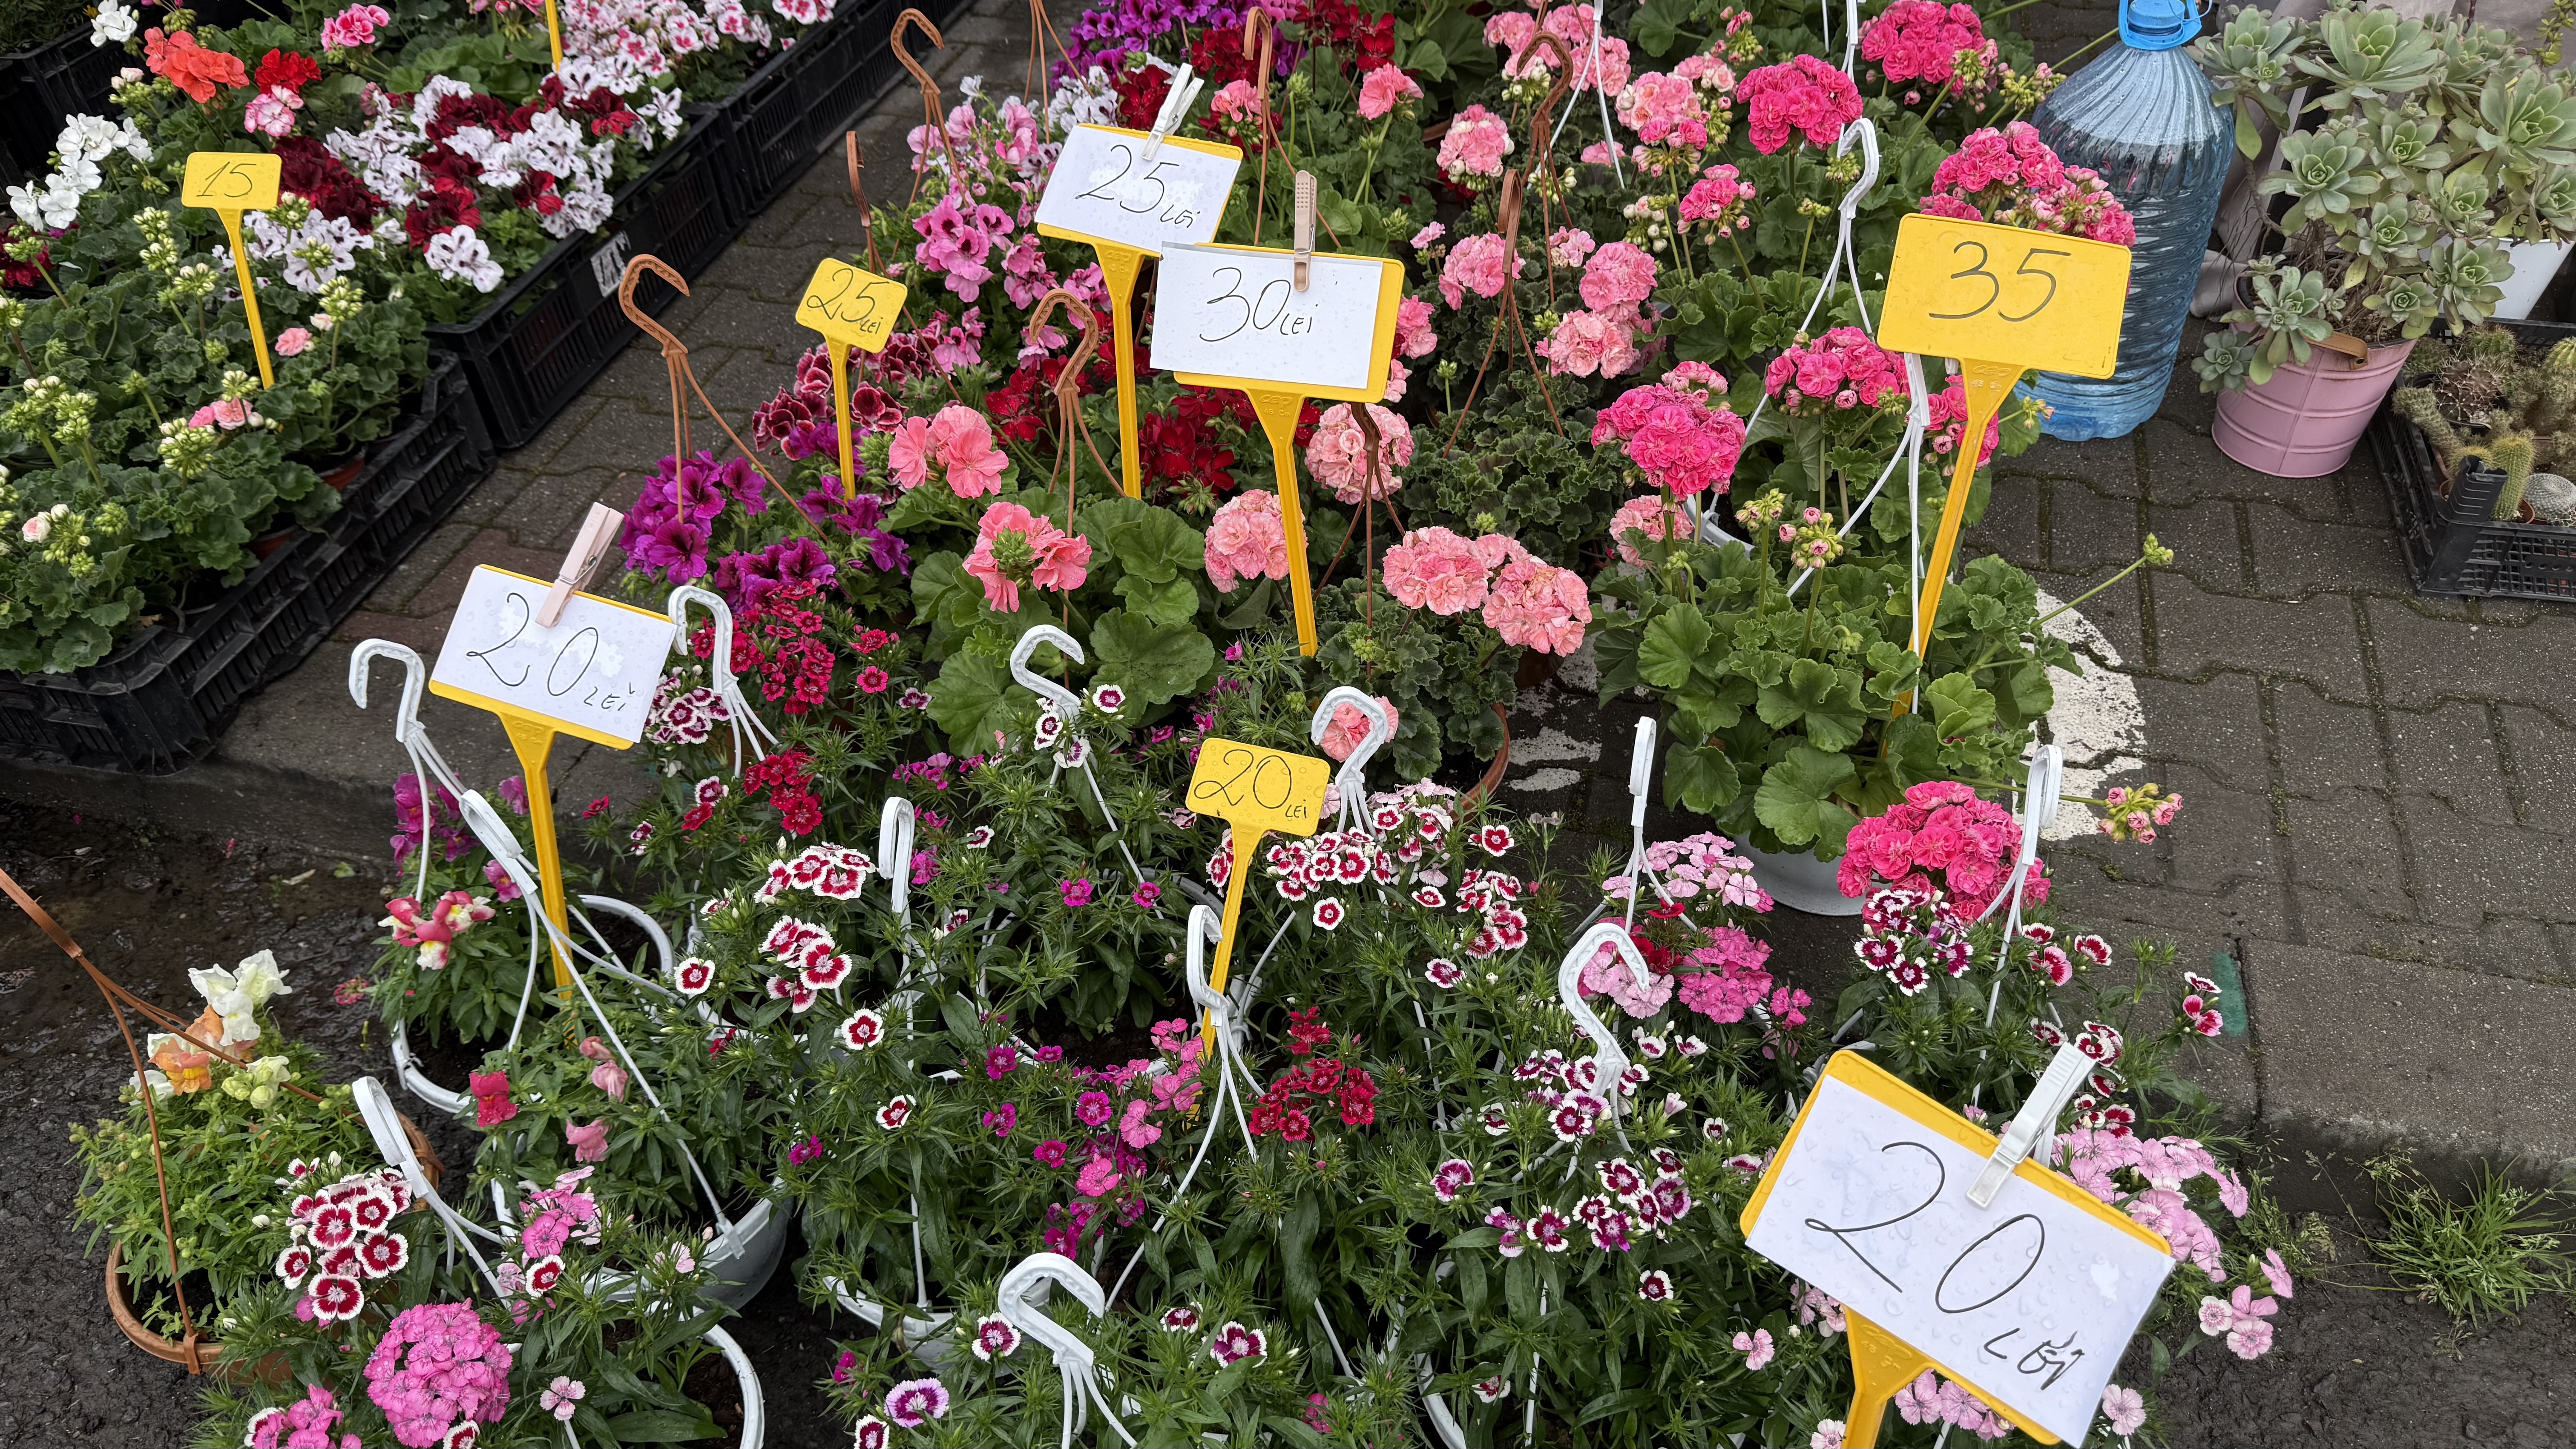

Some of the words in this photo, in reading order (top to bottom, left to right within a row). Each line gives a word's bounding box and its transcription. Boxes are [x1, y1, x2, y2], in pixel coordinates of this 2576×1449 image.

[196, 161, 257, 198] 15
[1075, 144, 1179, 213] 25
[806, 268, 890, 322] 25
[1199, 267, 1291, 342] 30
[1928, 241, 2071, 322] 35
[466, 592, 598, 696] 20
[1194, 749, 1292, 809] 20
[1805, 1141, 2045, 1314] 20
